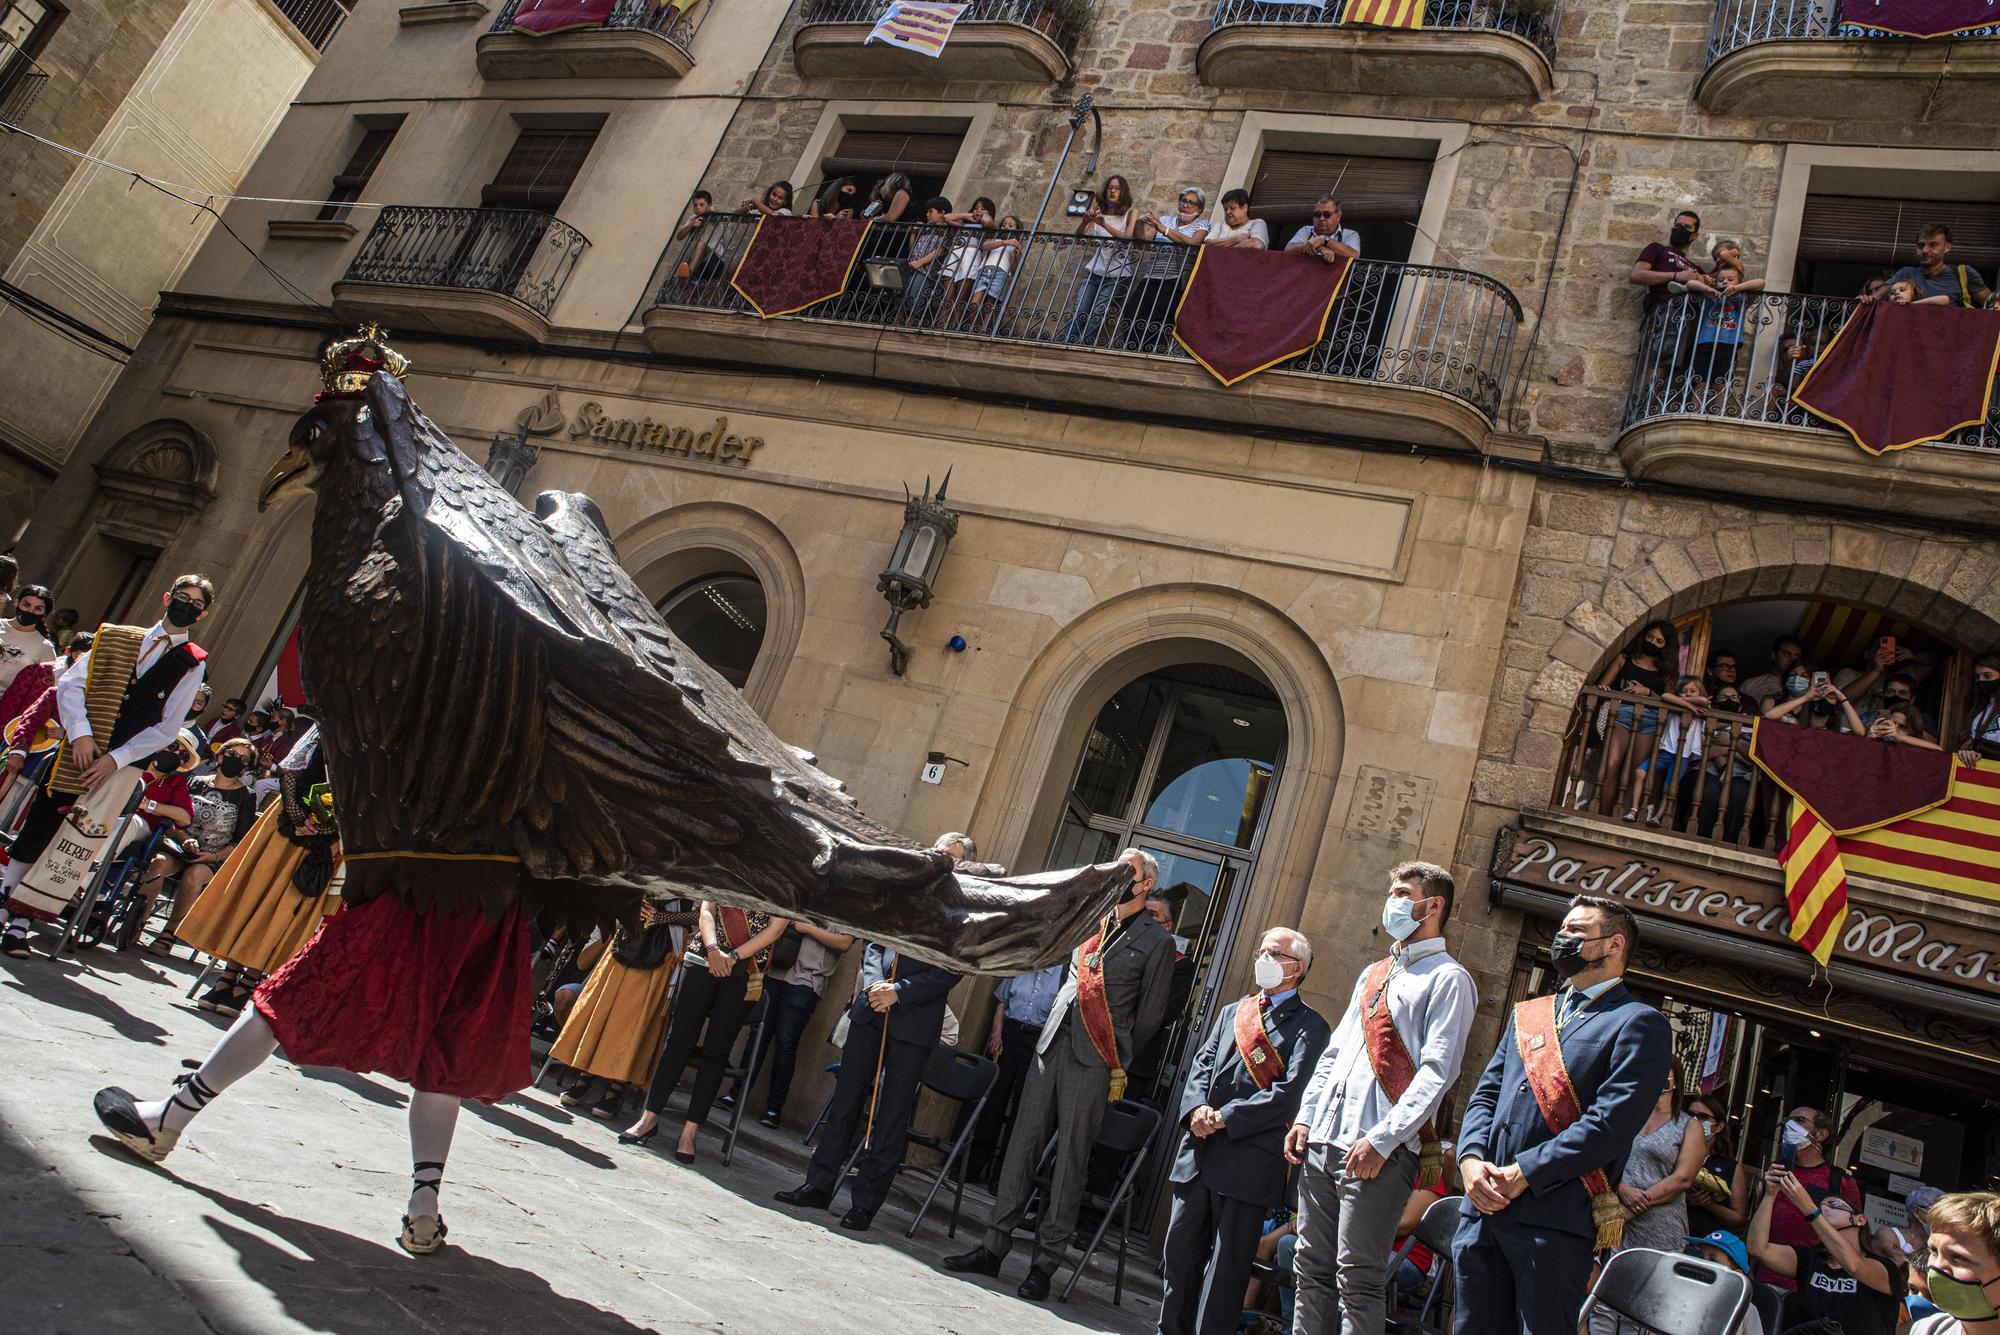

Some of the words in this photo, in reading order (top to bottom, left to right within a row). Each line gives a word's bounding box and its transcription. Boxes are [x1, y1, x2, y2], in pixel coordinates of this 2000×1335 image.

[568, 401, 765, 461] Santander
[928, 765, 938, 778] 6
[56, 838, 94, 861] HEREU
